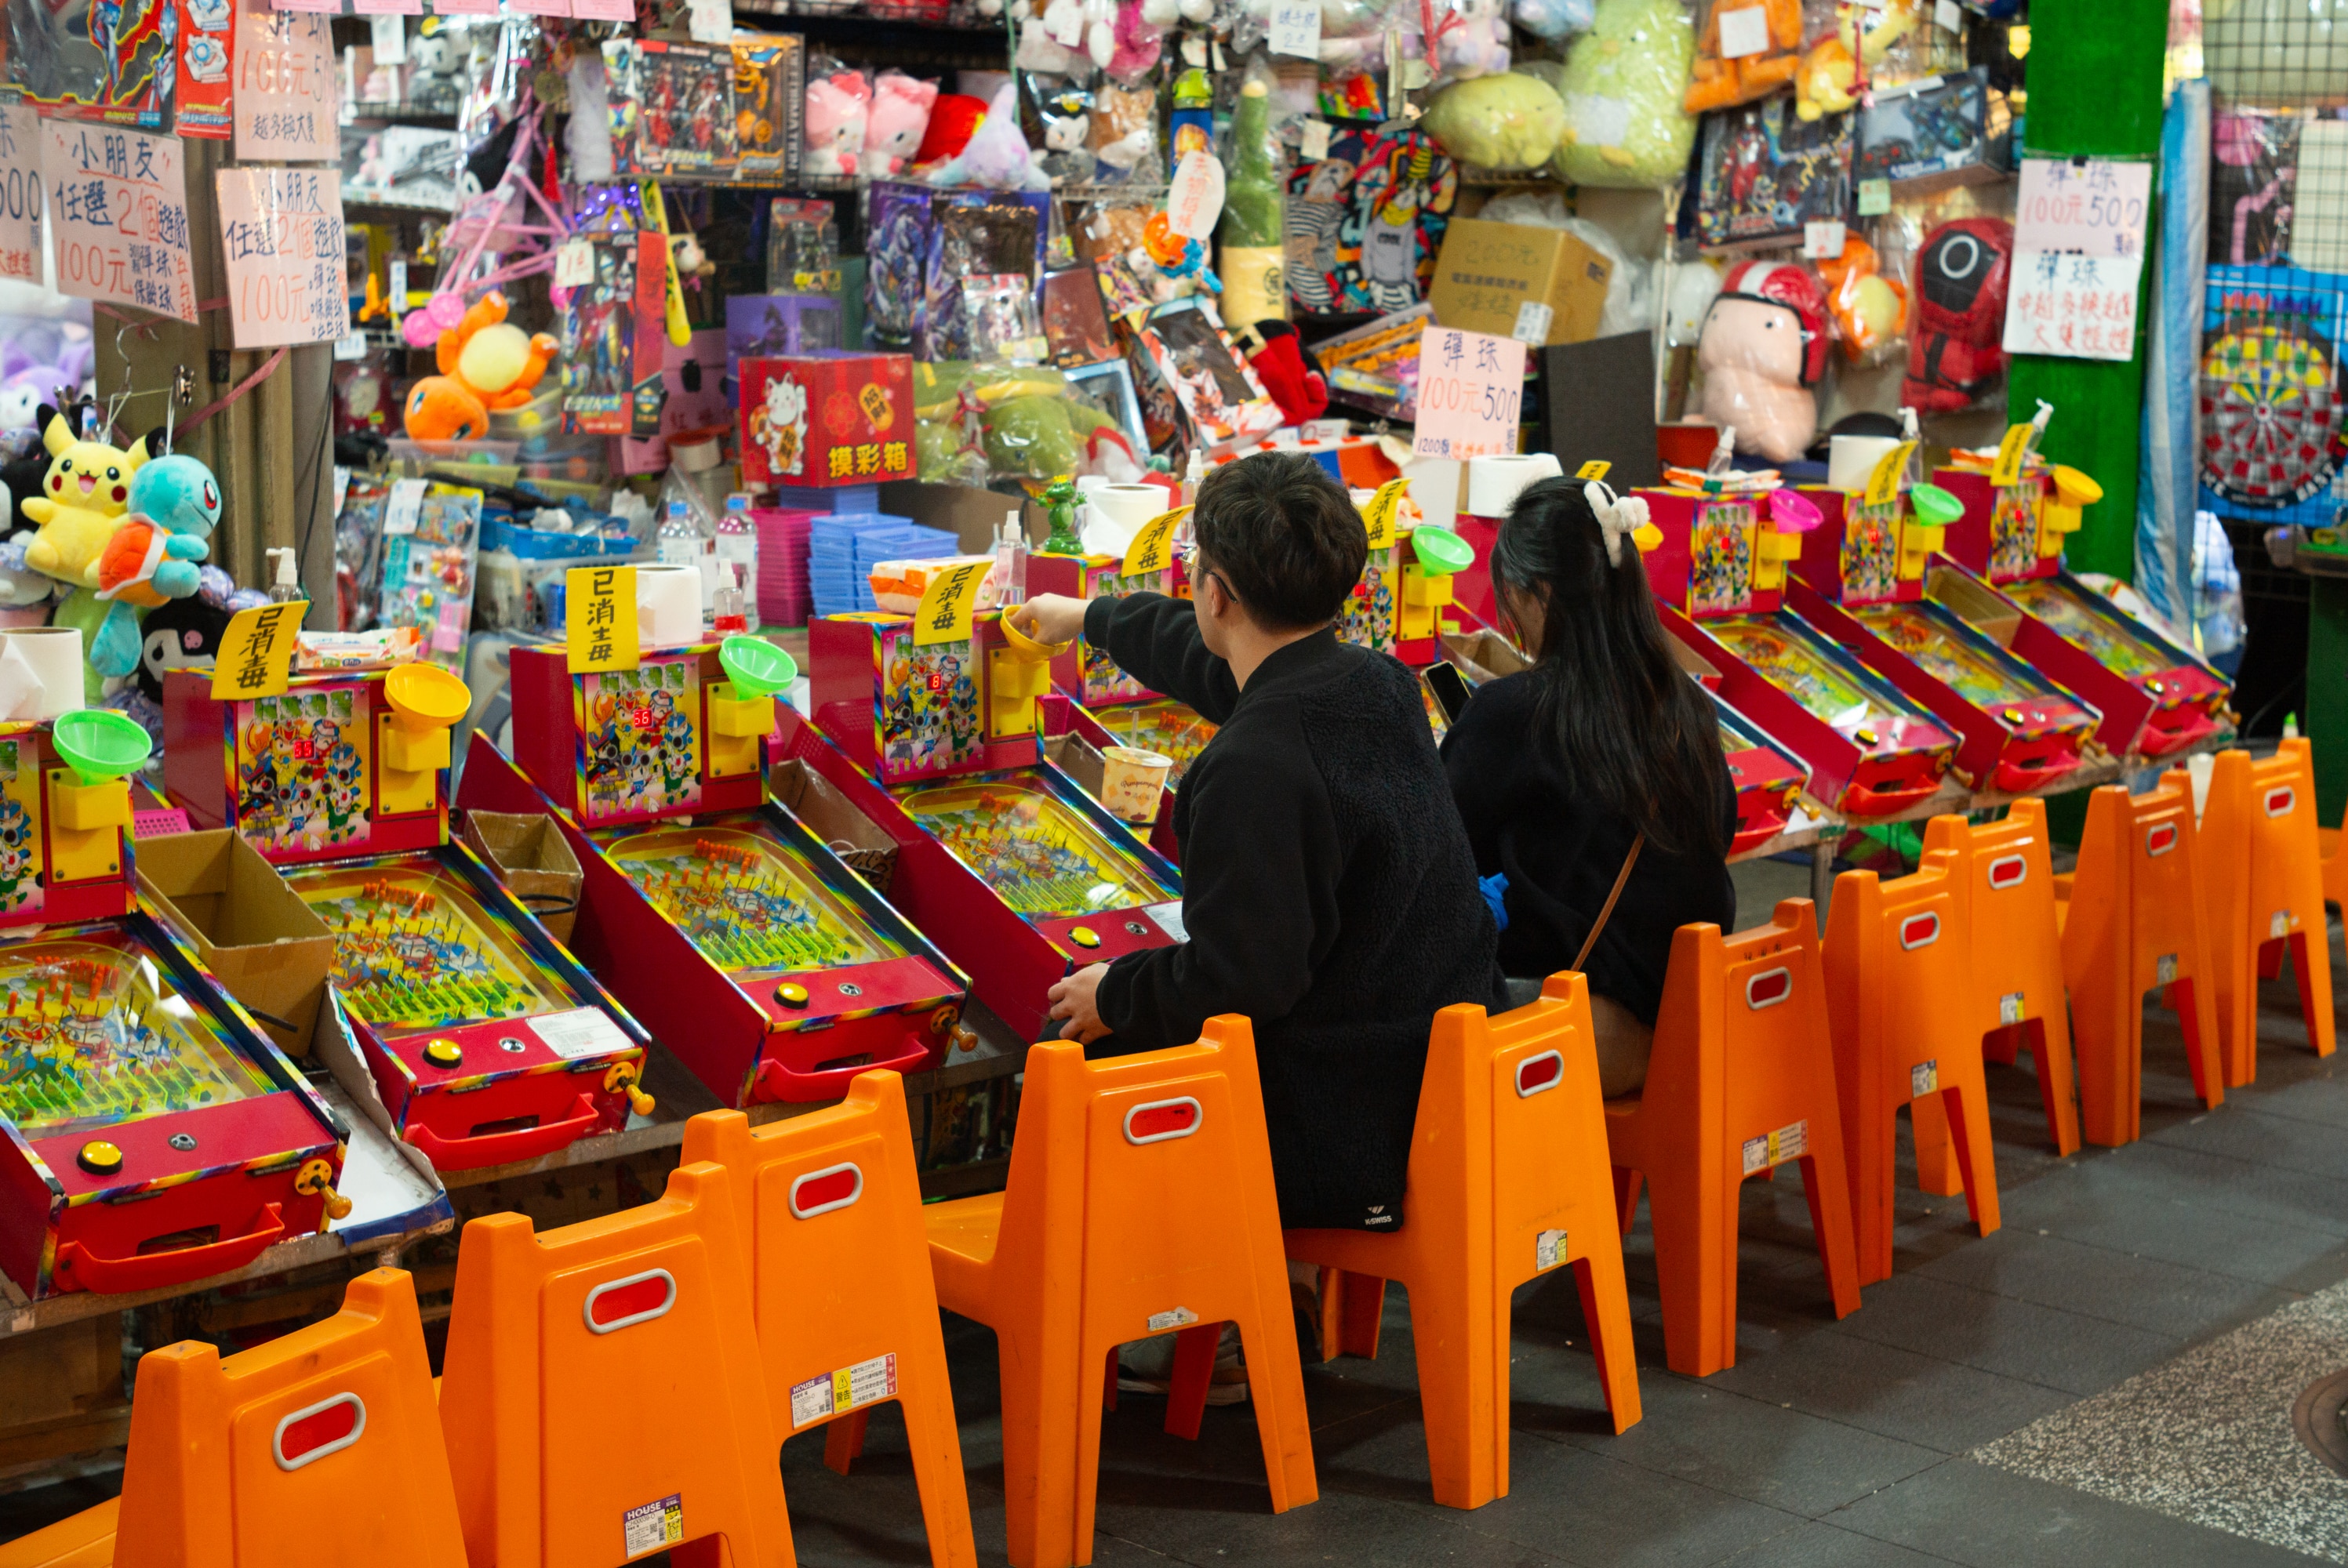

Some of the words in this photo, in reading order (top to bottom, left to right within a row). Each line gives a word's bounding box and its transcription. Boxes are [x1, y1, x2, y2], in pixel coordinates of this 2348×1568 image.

[72, 131, 158, 181] 小朋友
[261, 172, 323, 212] 小朋友
[2024, 194, 2084, 225] 100元
[2087, 195, 2143, 227] 500
[60, 238, 133, 294] 100元
[242, 274, 311, 324] 100元
[1443, 332, 1501, 372] 彈珠
[1421, 376, 1481, 412] 100元
[1482, 384, 1517, 423] 500
[828, 441, 907, 478] 摸彩箱
[1138, 510, 1183, 570] 已消毒
[587, 569, 615, 662] 已消毒
[932, 564, 976, 630] 已消毒
[237, 608, 284, 690] 已消毒
[932, 675, 940, 688] 8
[793, 1379, 816, 1393] HOUSE
[835, 1388, 851, 1403] 警告
[627, 1501, 661, 1520] HOUSE
